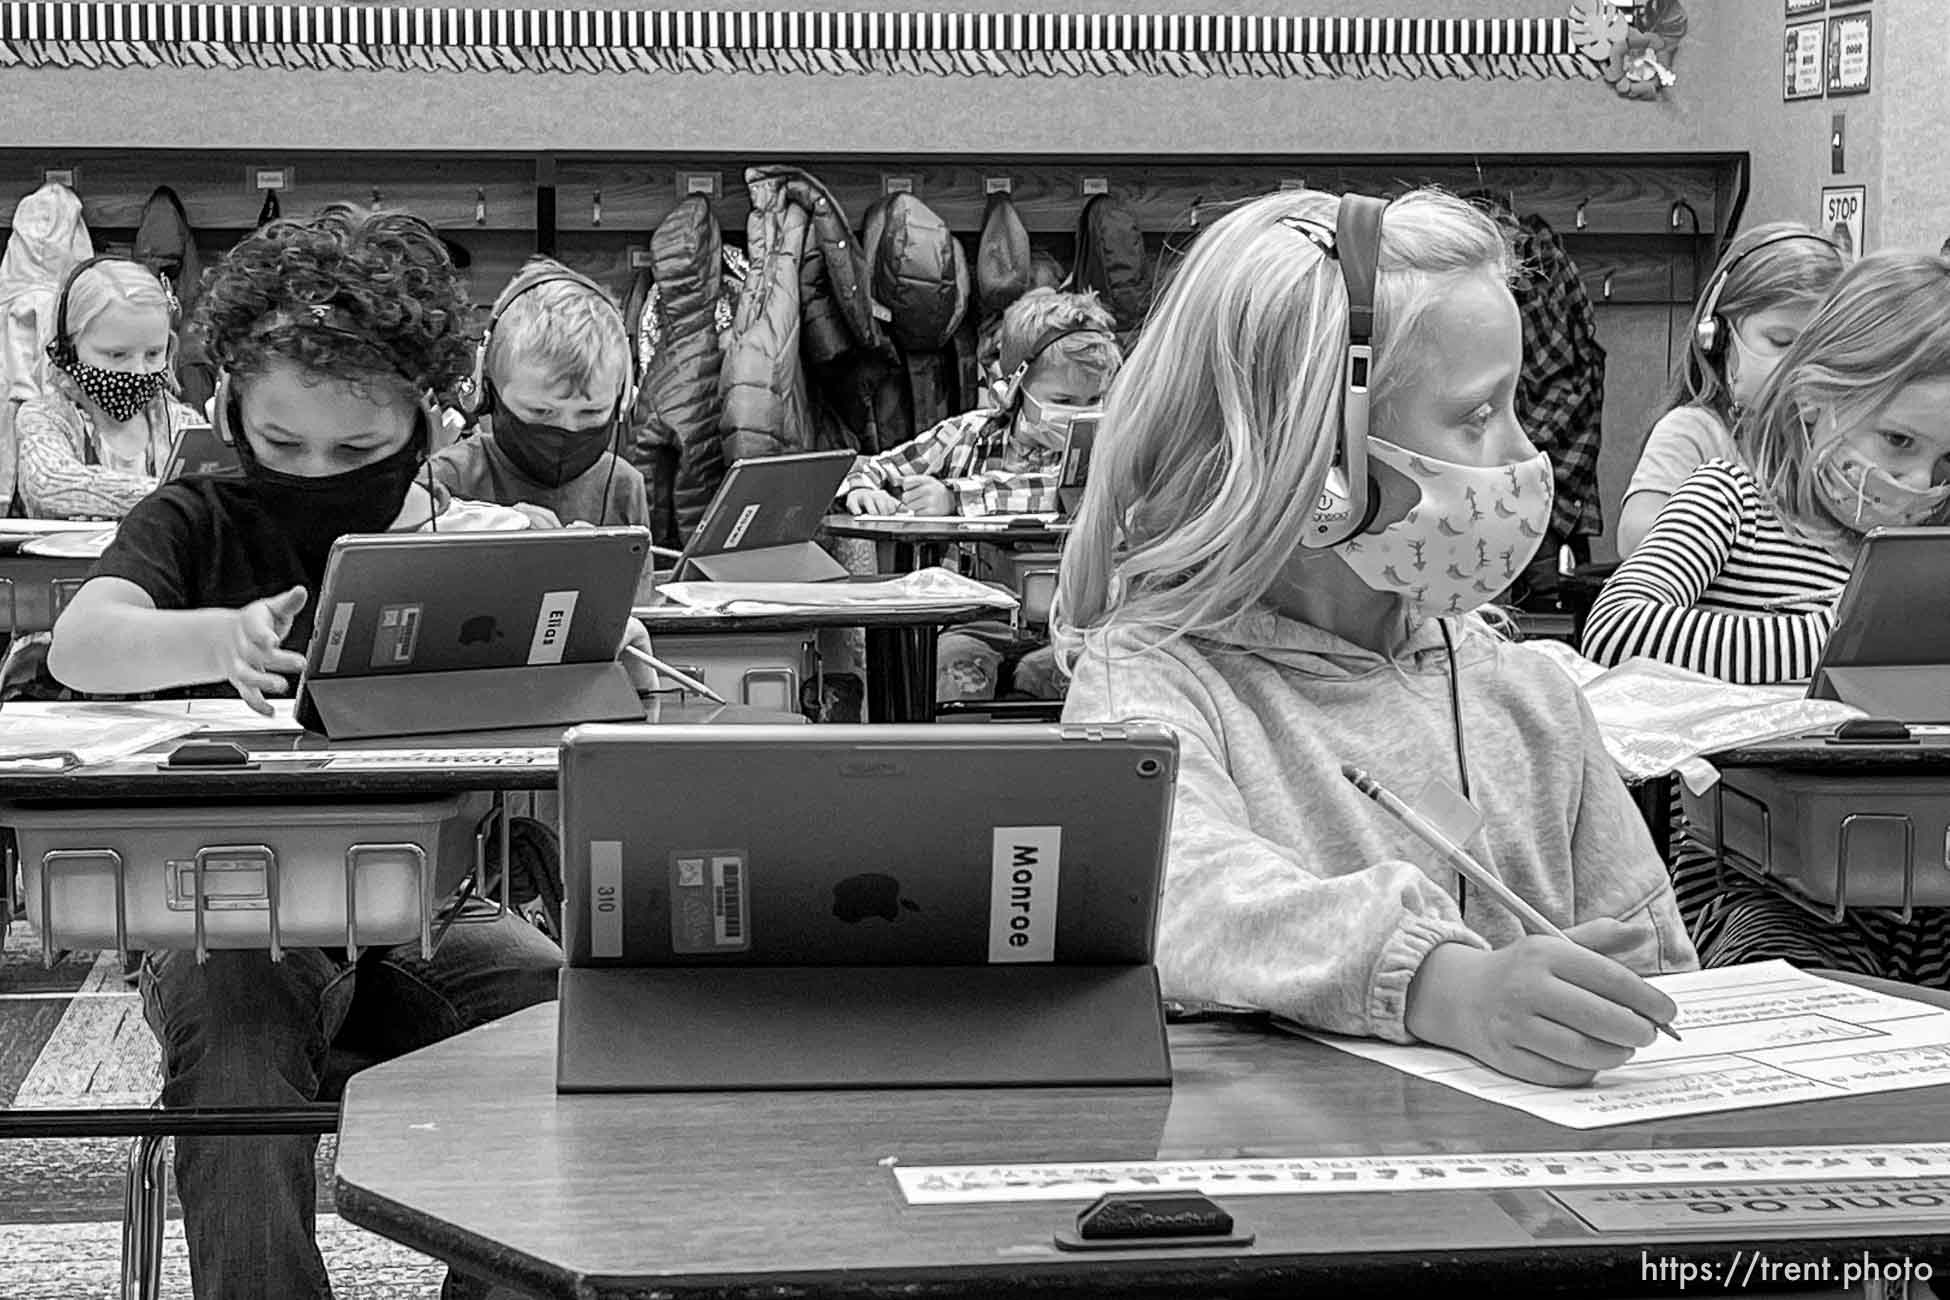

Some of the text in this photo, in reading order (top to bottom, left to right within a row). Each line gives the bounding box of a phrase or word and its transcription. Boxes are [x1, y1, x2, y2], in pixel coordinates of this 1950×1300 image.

[1829, 196, 1858, 222] STOP
[543, 609, 565, 646] Elias
[597, 885, 616, 913] 310
[1008, 845, 1039, 947] Monroe
[1686, 1193, 1950, 1214] onroe
